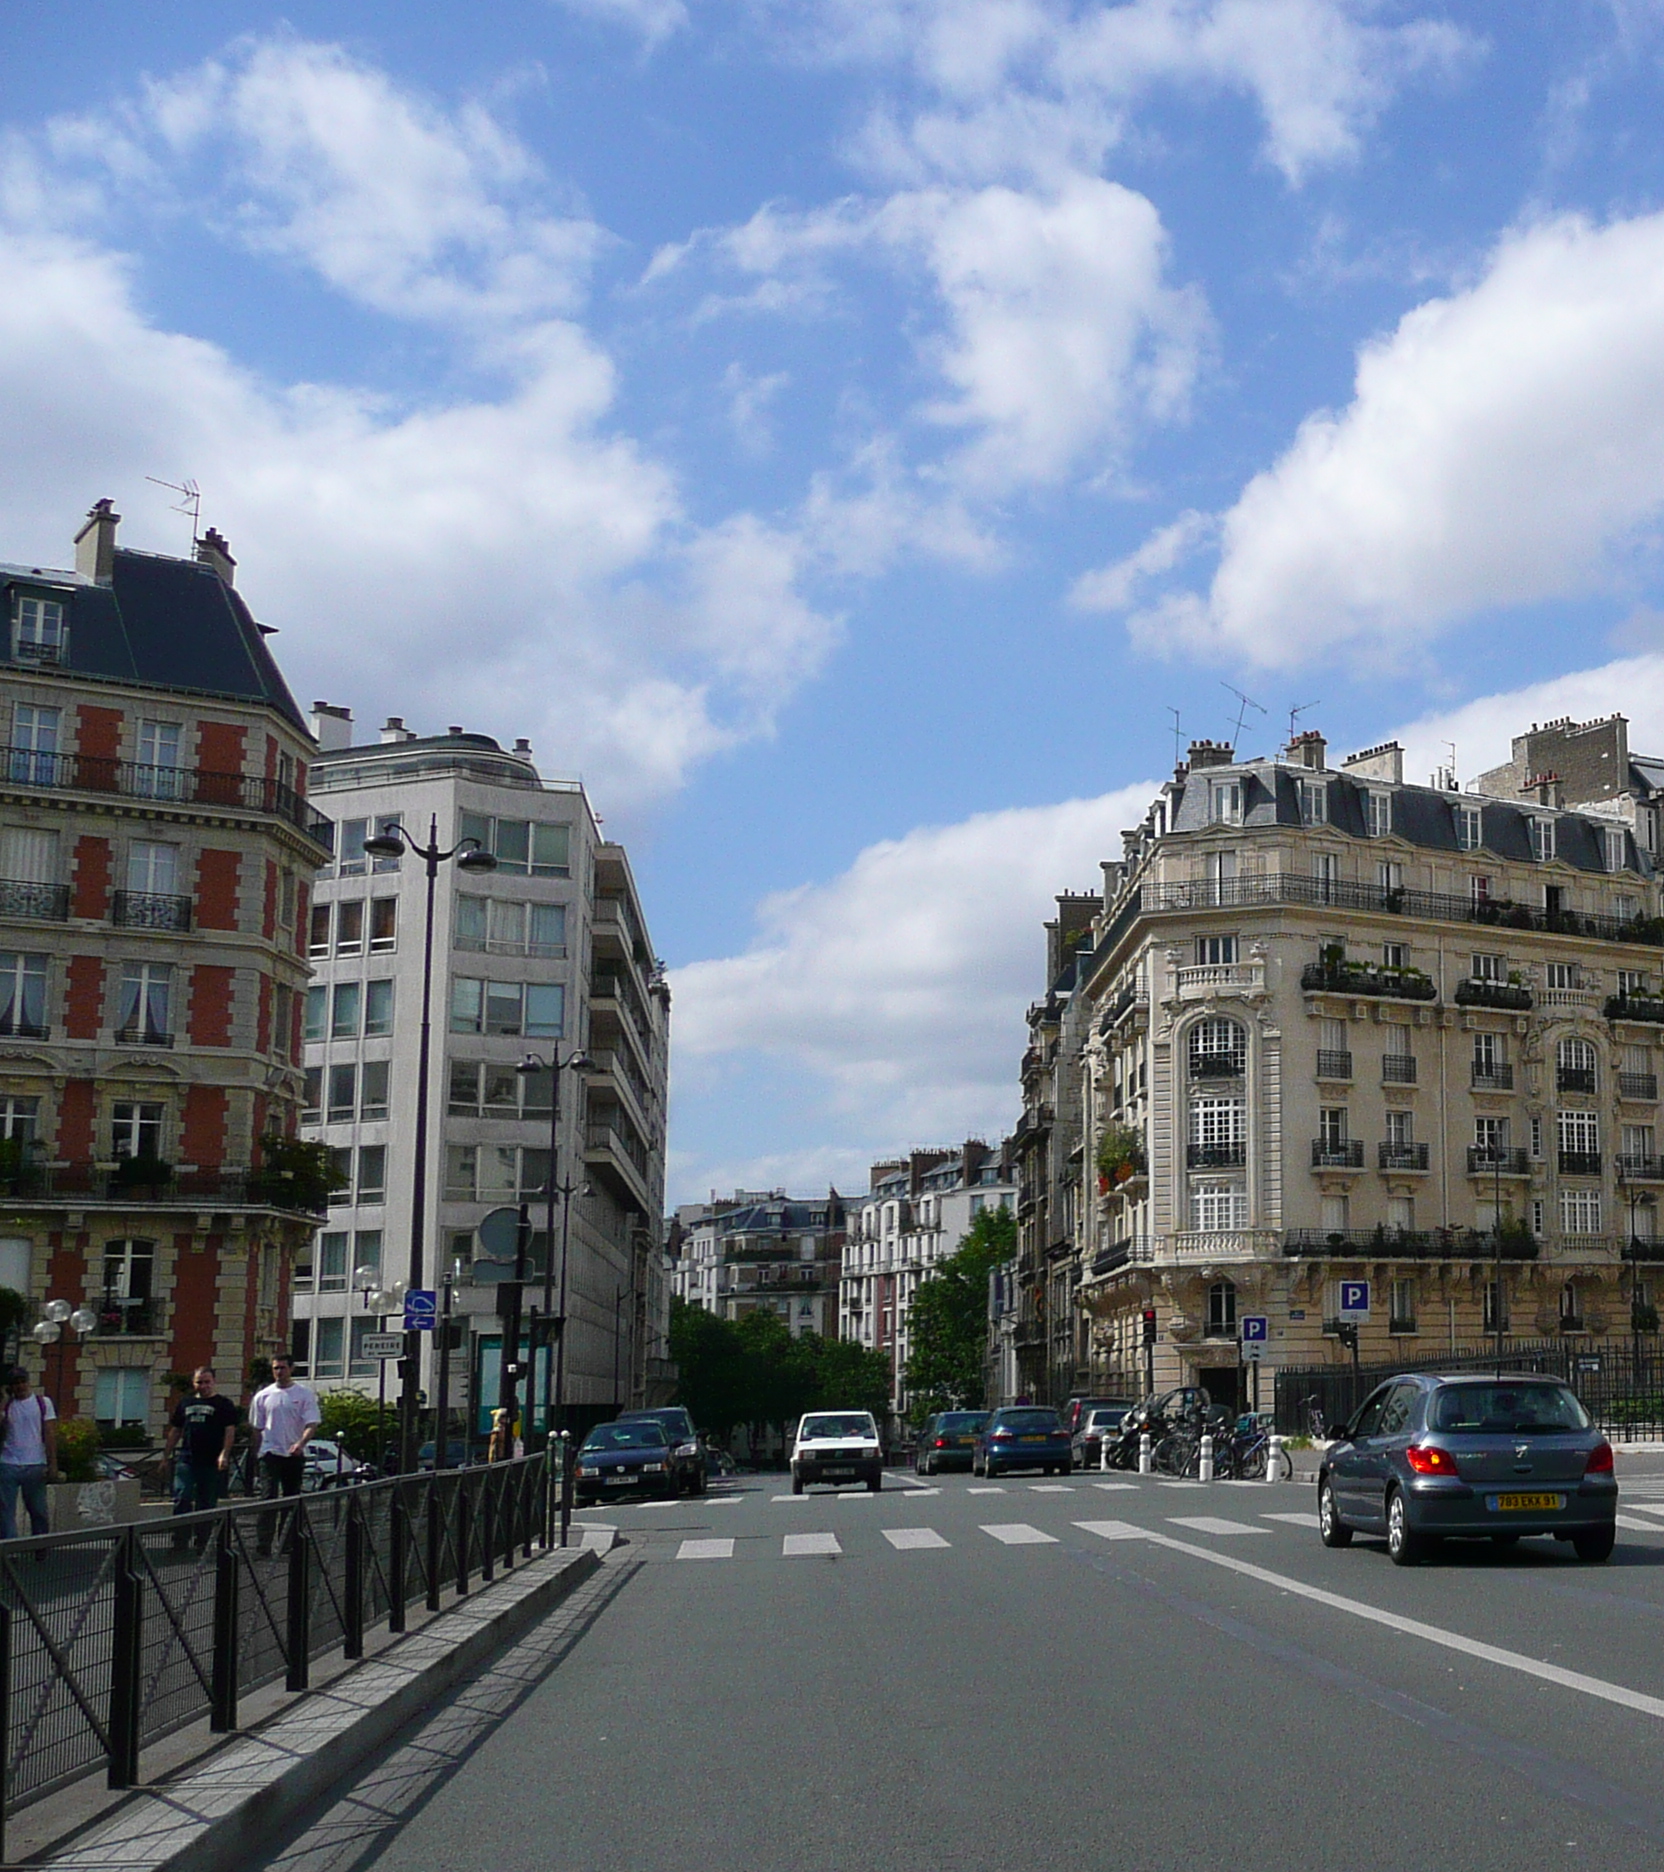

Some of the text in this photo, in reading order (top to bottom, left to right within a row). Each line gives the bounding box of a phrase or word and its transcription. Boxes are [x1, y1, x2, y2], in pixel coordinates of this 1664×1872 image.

[1348, 1287, 1361, 1306] P
[1249, 1321, 1260, 1337] P
[1544, 1495, 1556, 1505] 91
